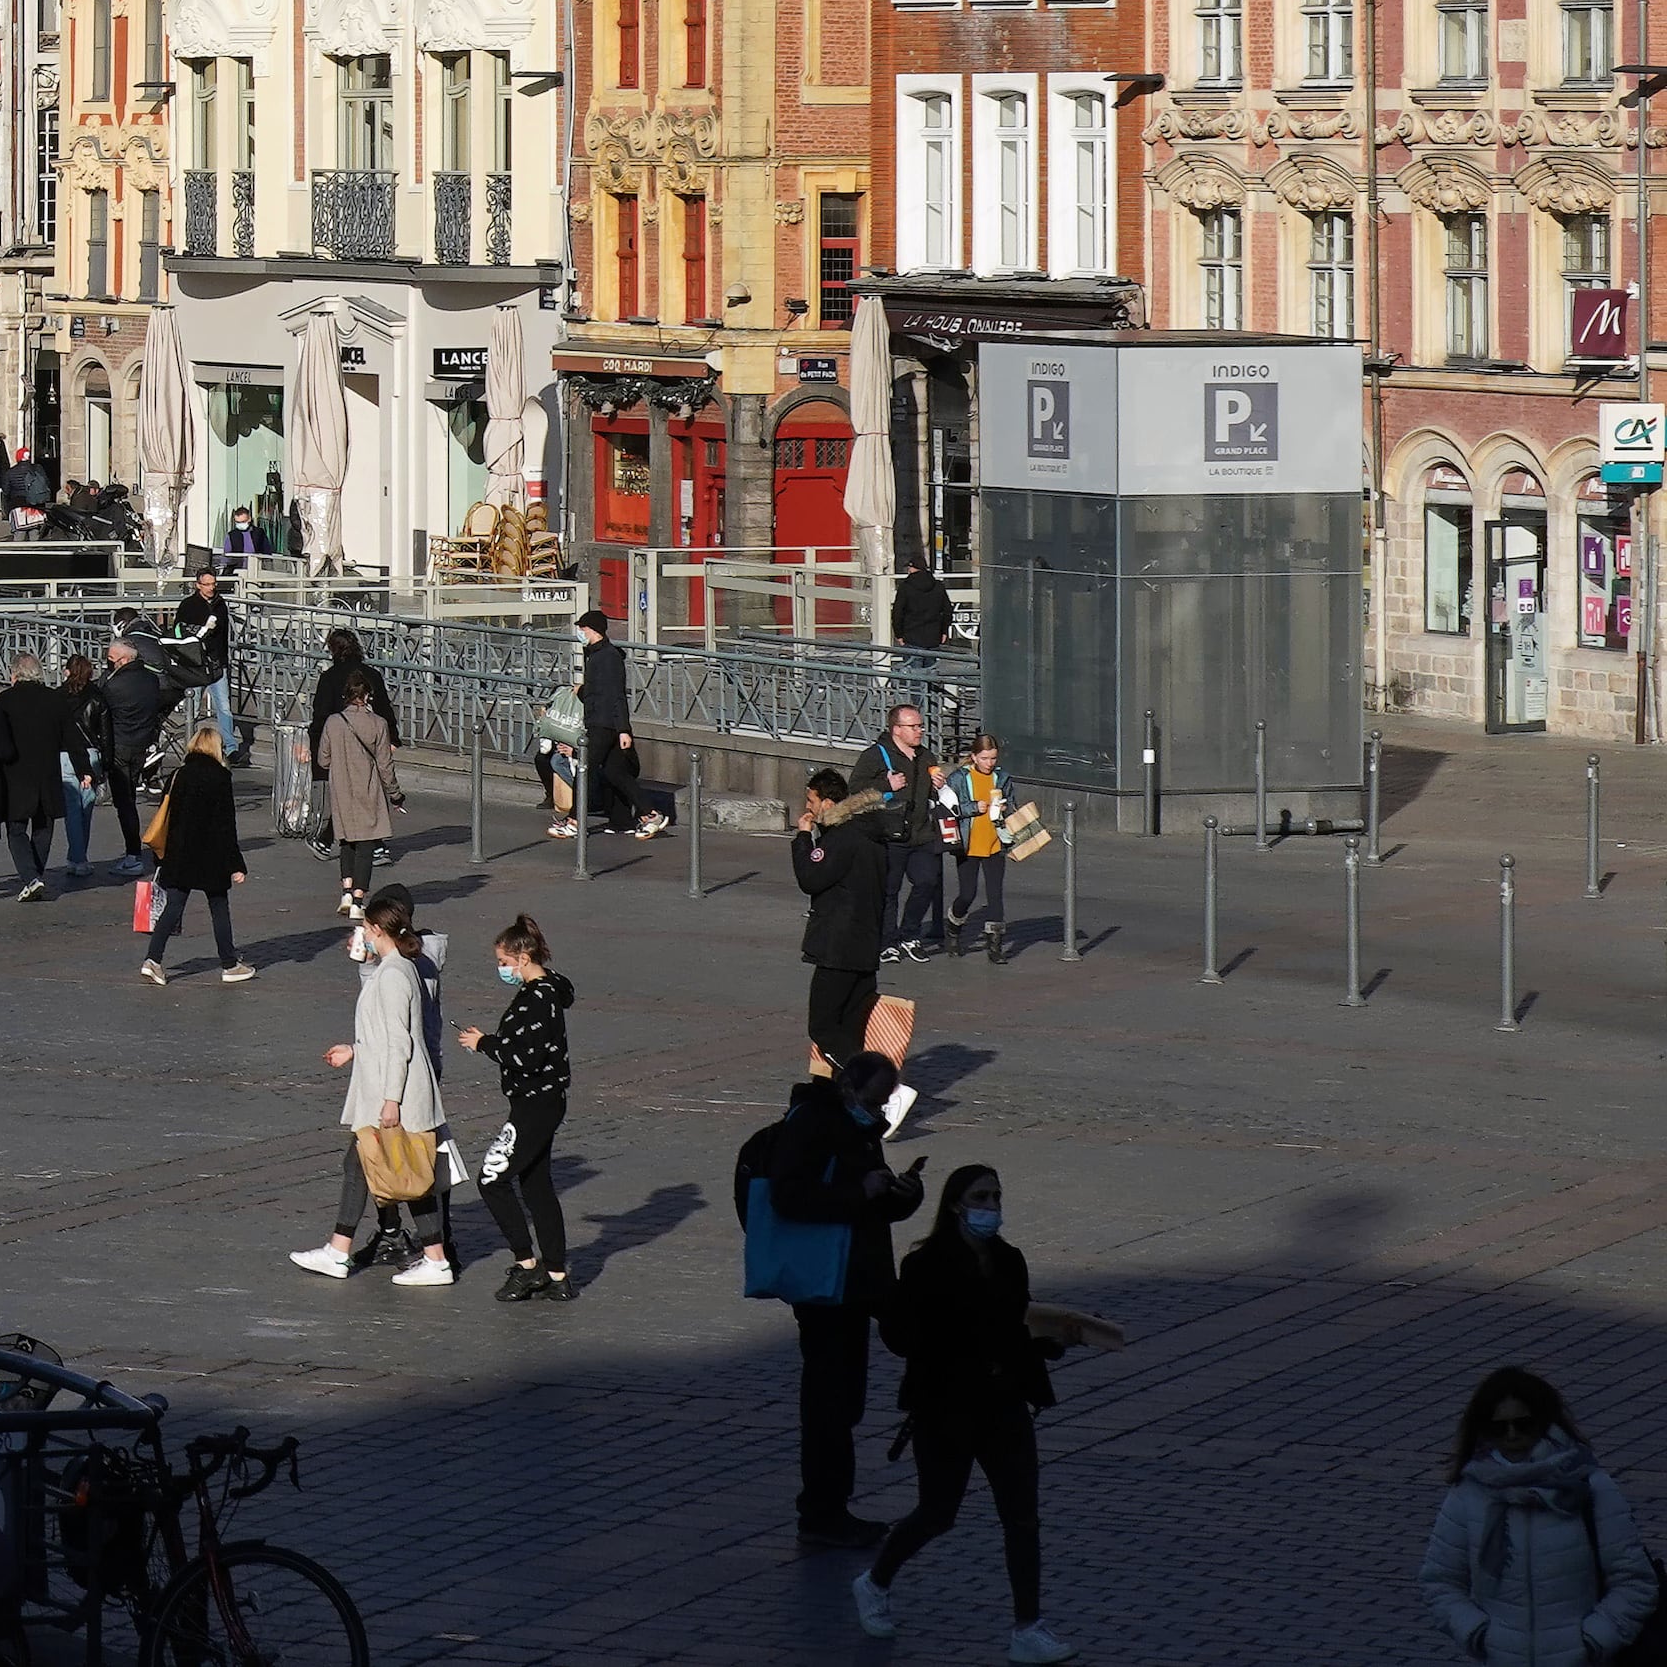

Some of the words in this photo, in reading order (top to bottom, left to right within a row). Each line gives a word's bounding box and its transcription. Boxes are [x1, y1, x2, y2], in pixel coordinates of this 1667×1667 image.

[903, 315, 921, 328] LA
[441, 352, 489, 365] LANCE
[603, 359, 621, 373] COQ
[624, 360, 653, 373] HARDI
[1031, 362, 1066, 376] INDIGO
[1213, 365, 1270, 378] INDIGO
[226, 371, 252, 384] LANCEL
[1033, 386, 1055, 439] P
[1215, 390, 1253, 443] P
[1214, 447, 1244, 455] GRAND
[1244, 447, 1268, 455] PLACE
[1209, 468, 1220, 476] LA
[1222, 468, 1263, 476] BOUTIQUE
[522, 591, 552, 601] SALLE
[554, 592, 568, 601] AU
